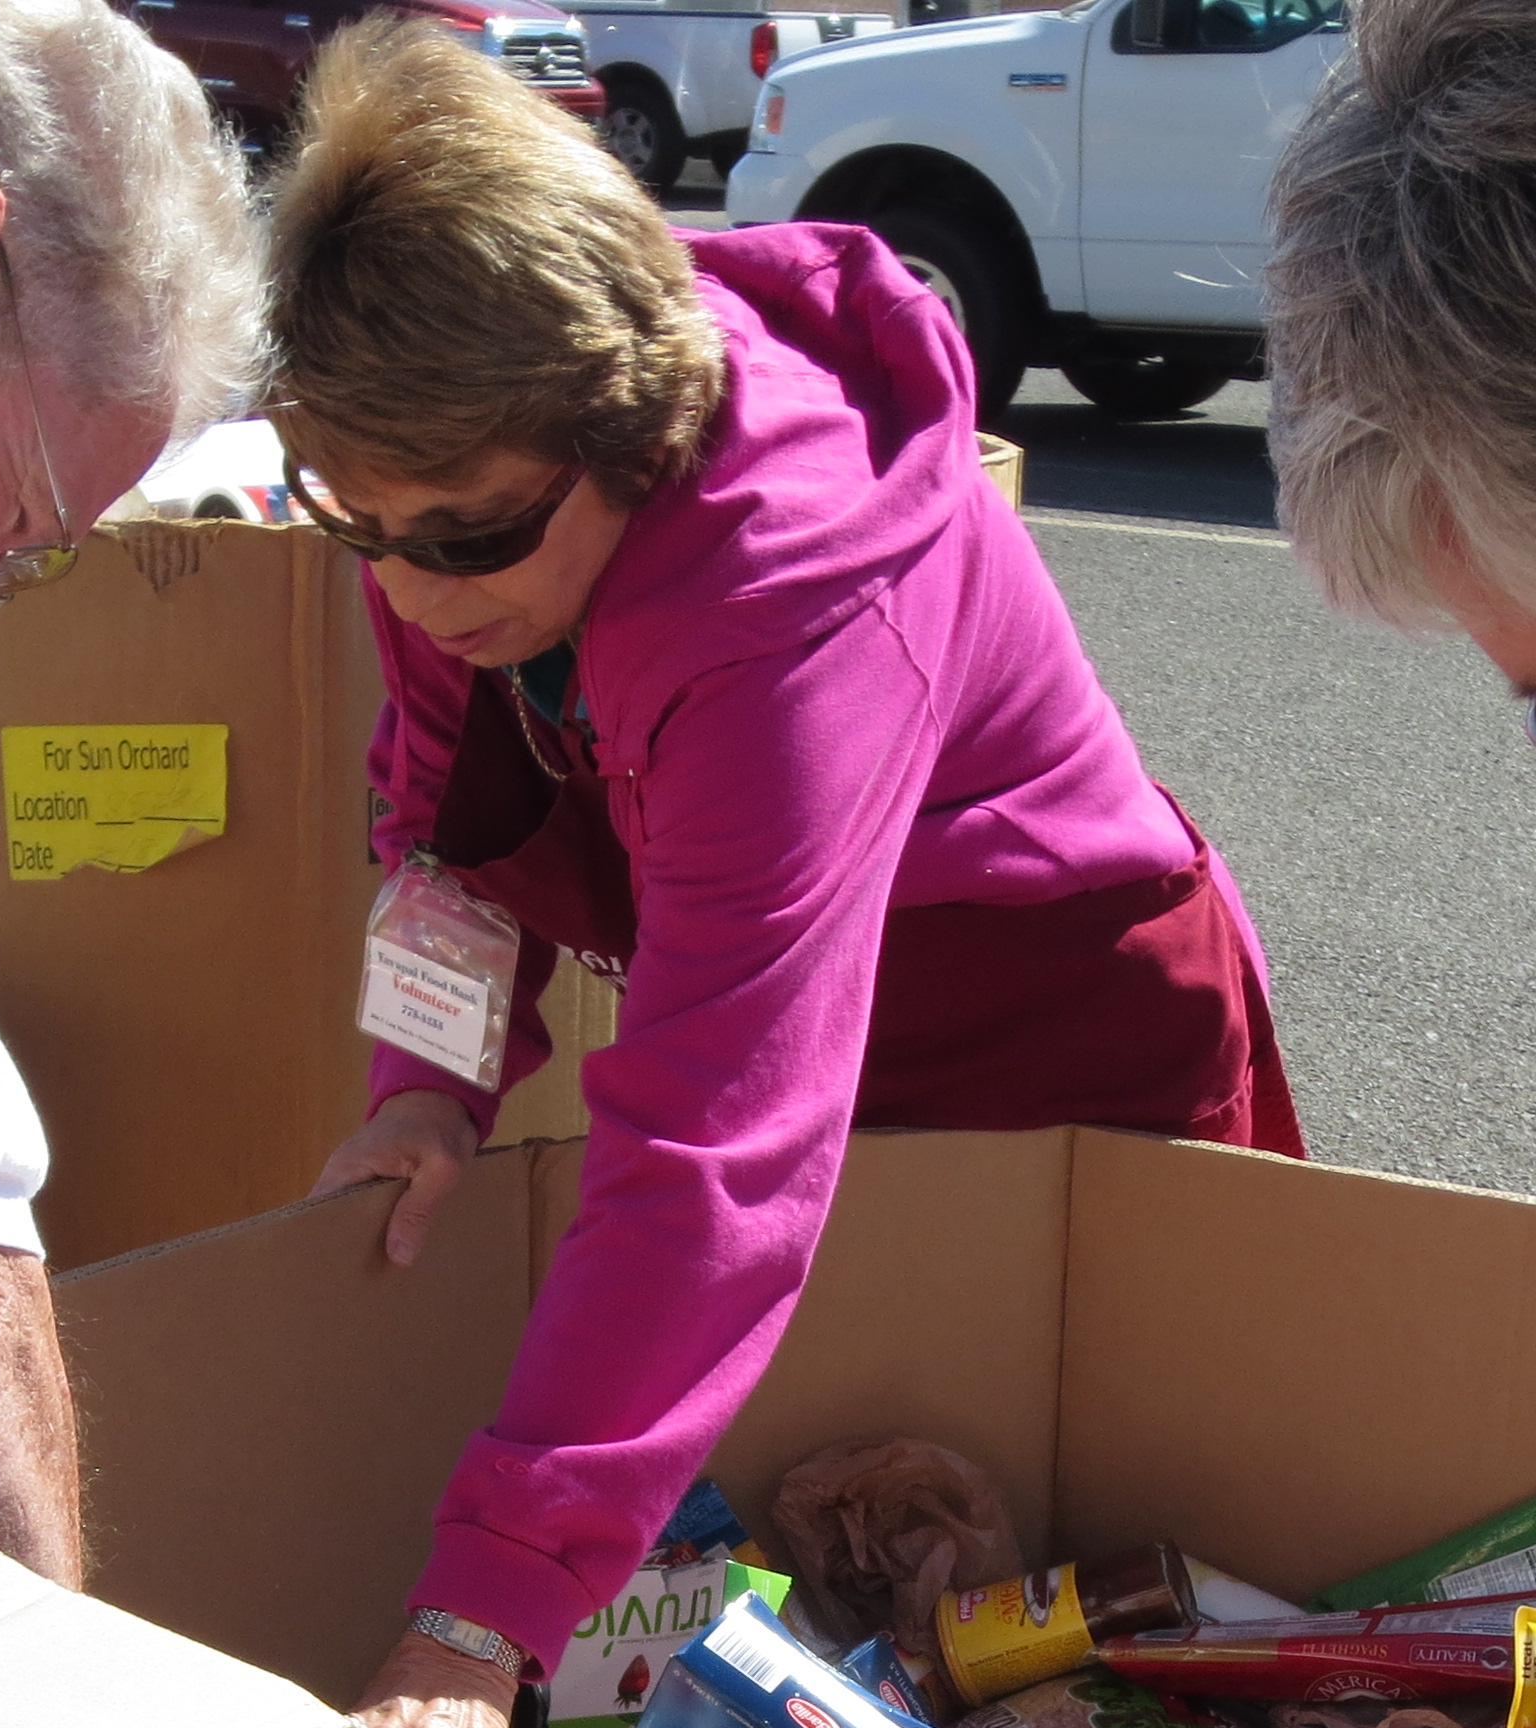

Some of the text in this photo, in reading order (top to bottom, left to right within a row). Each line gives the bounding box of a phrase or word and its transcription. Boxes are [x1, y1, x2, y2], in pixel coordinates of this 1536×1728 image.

[42, 738, 189, 771] For Sun Orchard
[13, 790, 89, 824] Location
[12, 841, 54, 871] Date
[393, 972, 462, 1017] Volunteer
[1414, 1646, 1477, 1662] BEAUTY
[1523, 1641, 1533, 1679] Heat
[1312, 1672, 1407, 1702] MERICA
